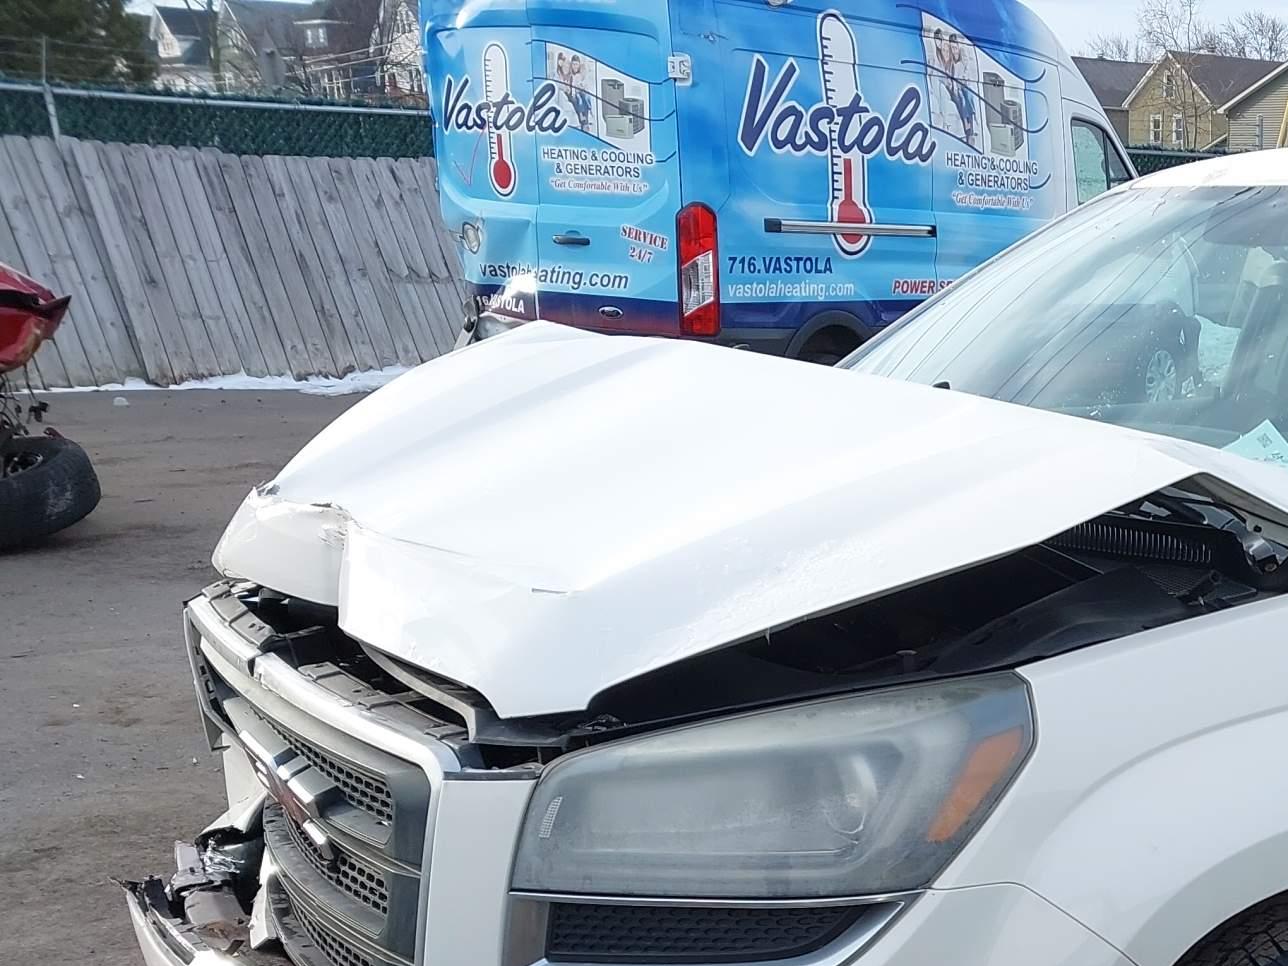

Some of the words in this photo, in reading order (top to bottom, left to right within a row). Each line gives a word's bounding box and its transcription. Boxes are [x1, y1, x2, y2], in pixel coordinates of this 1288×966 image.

[443, 76, 568, 133] Vastola
[740, 57, 937, 163] Vastola
[542, 147, 588, 161] HEATING
[591, 150, 598, 161] &
[601, 150, 654, 165] COOLING
[946, 152, 988, 170] HEATING
[990, 156, 997, 171] &
[998, 158, 1038, 175] COOLING
[555, 162, 563, 174] &
[565, 163, 640, 178] GENERATORS
[568, 180, 611, 191] Comfortable
[613, 181, 630, 192] With
[957, 171, 964, 186] &
[967, 172, 1028, 191] GENERATORS
[968, 193, 1006, 208] Comfortable
[621, 225, 668, 250] SERVICE
[629, 246, 653, 264] 24/7
[727, 256, 833, 274] 716.VASTOLA
[727, 280, 855, 299] vastolaheating.com
[892, 280, 936, 295] POWER
